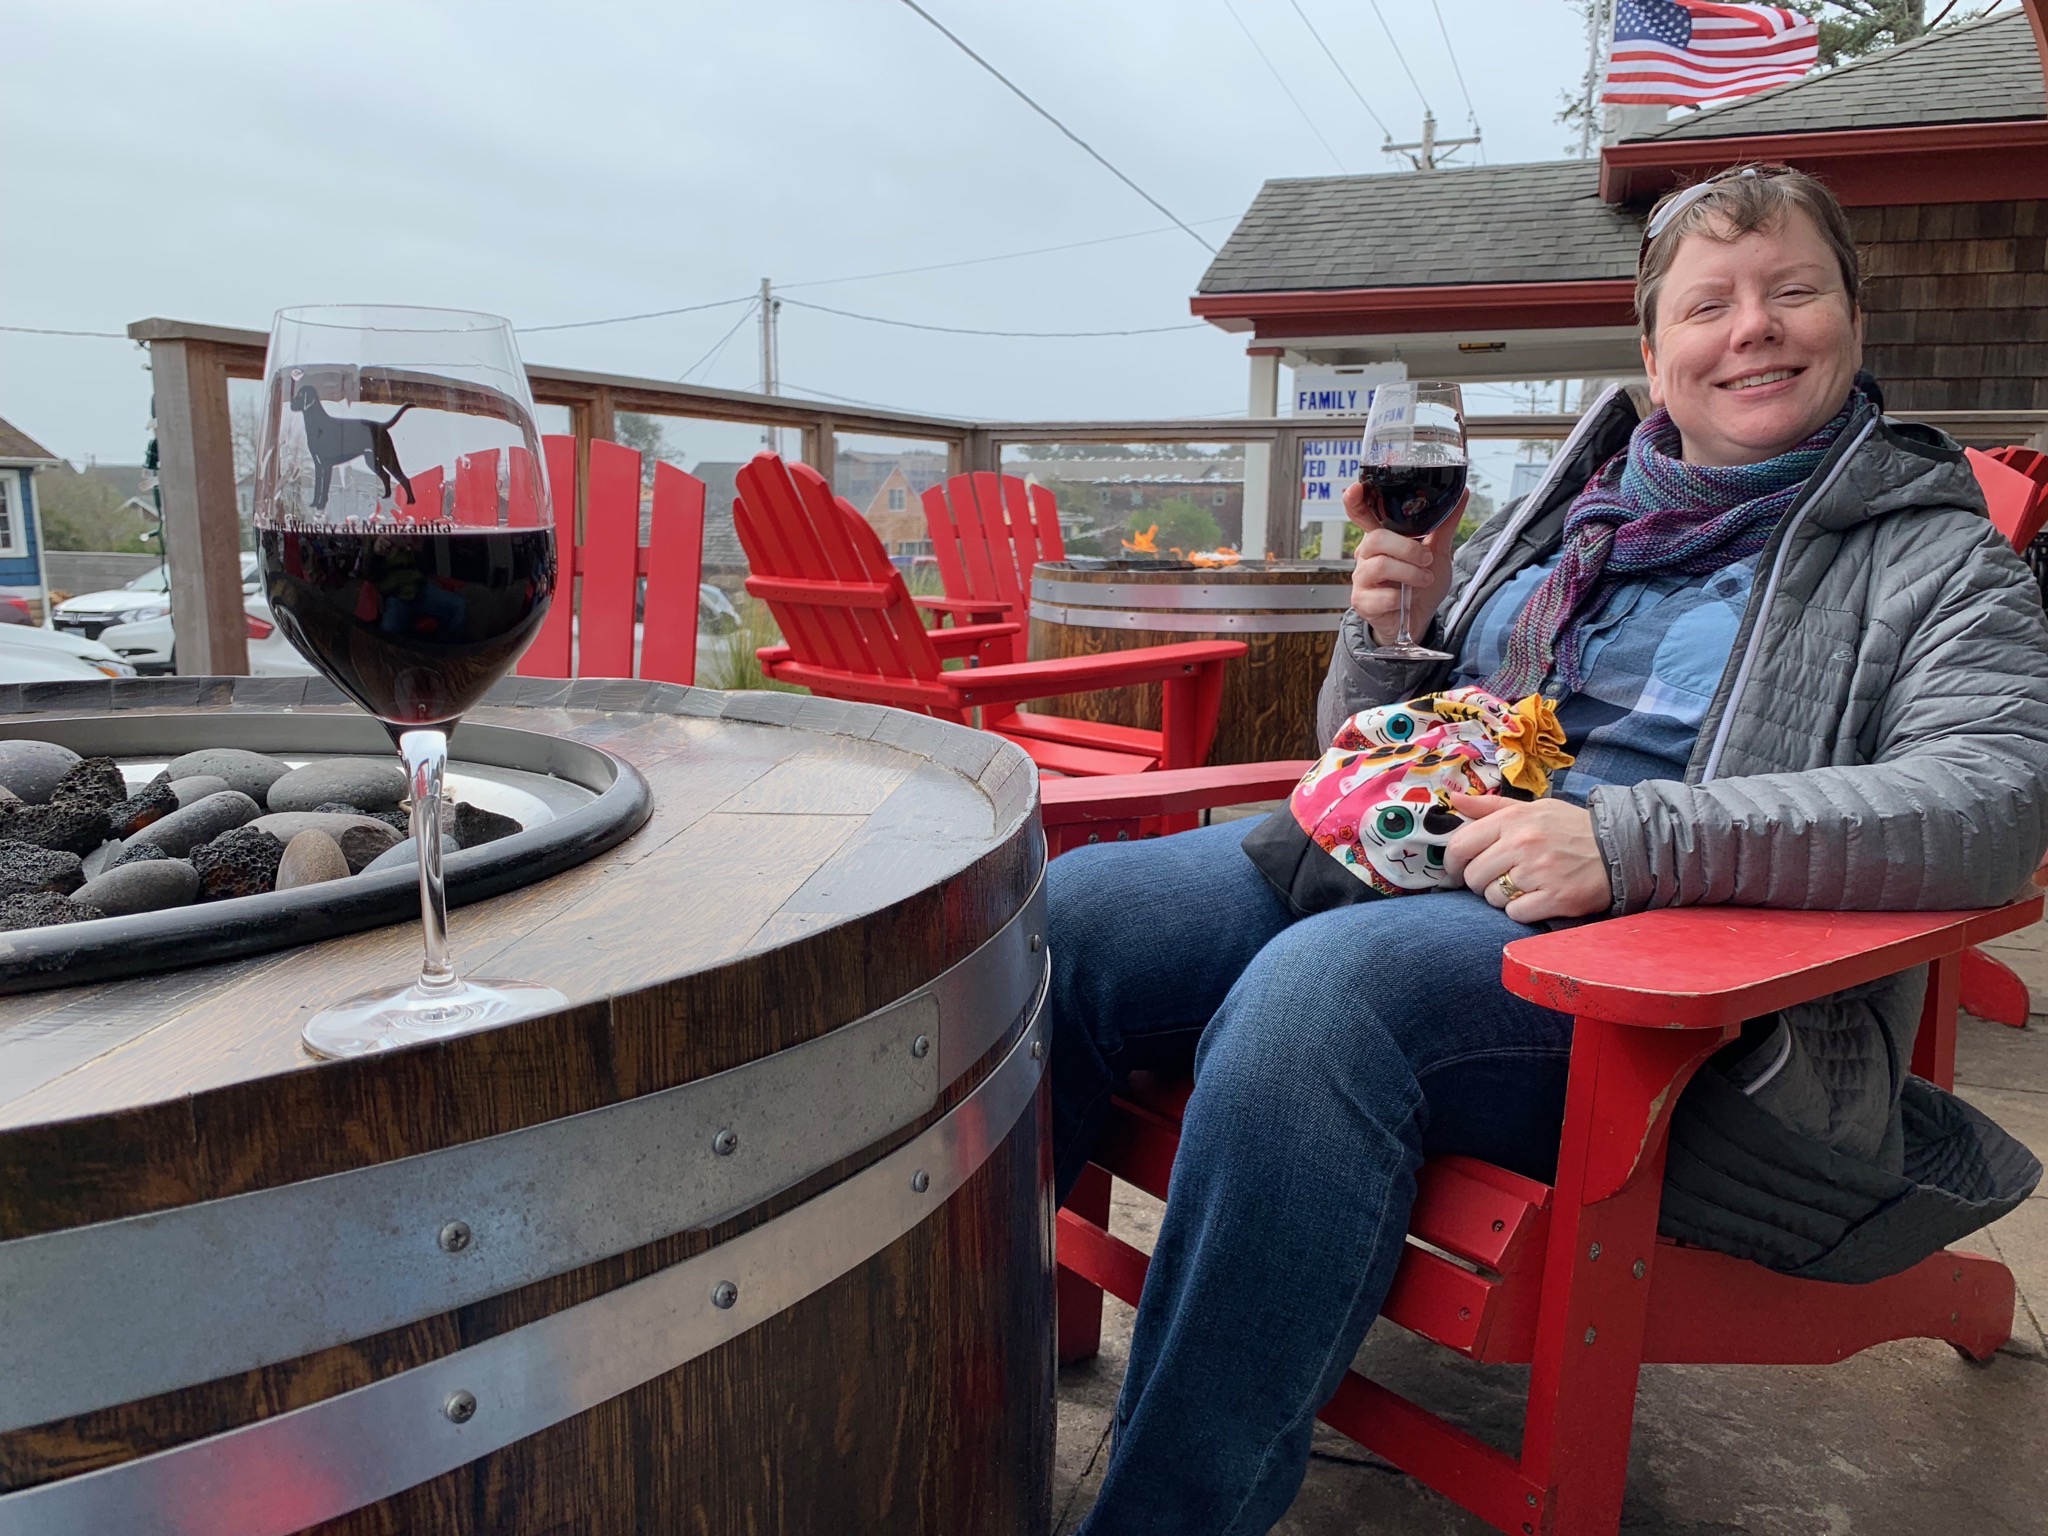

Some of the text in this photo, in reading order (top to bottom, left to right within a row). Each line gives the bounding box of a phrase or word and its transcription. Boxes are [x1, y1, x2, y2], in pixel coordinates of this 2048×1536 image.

[1299, 391, 1357, 410] FAMILY
[1304, 441, 1361, 455] ACTIVIT
[1338, 460, 1359, 477] AP
[269, 519, 452, 534] The Winery at Manzanita
